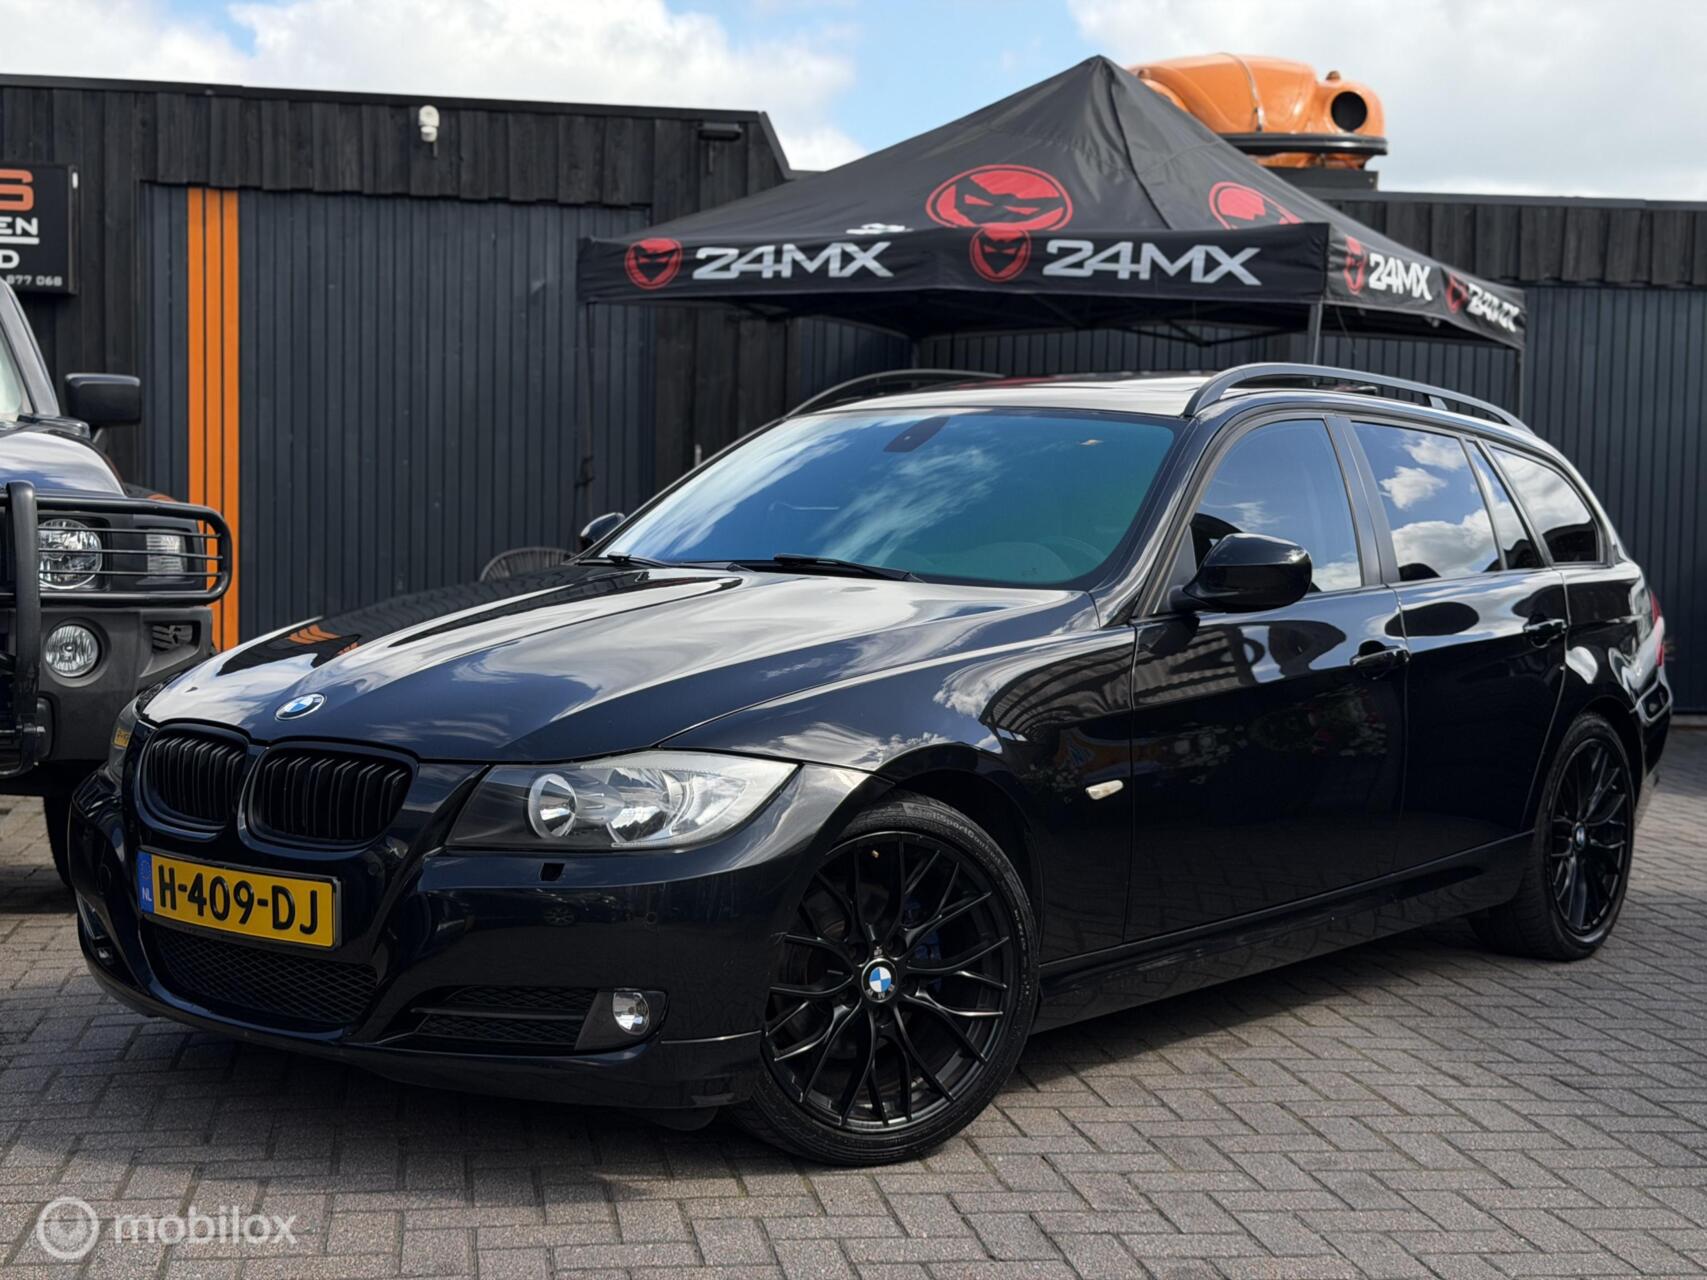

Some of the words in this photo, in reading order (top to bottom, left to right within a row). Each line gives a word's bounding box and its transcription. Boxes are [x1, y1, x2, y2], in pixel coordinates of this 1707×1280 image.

[692, 241, 894, 280] 24MX
[1043, 239, 1262, 286] 24MX
[1368, 252, 1433, 301] 24MX
[157, 863, 319, 935] H-409-DJ
